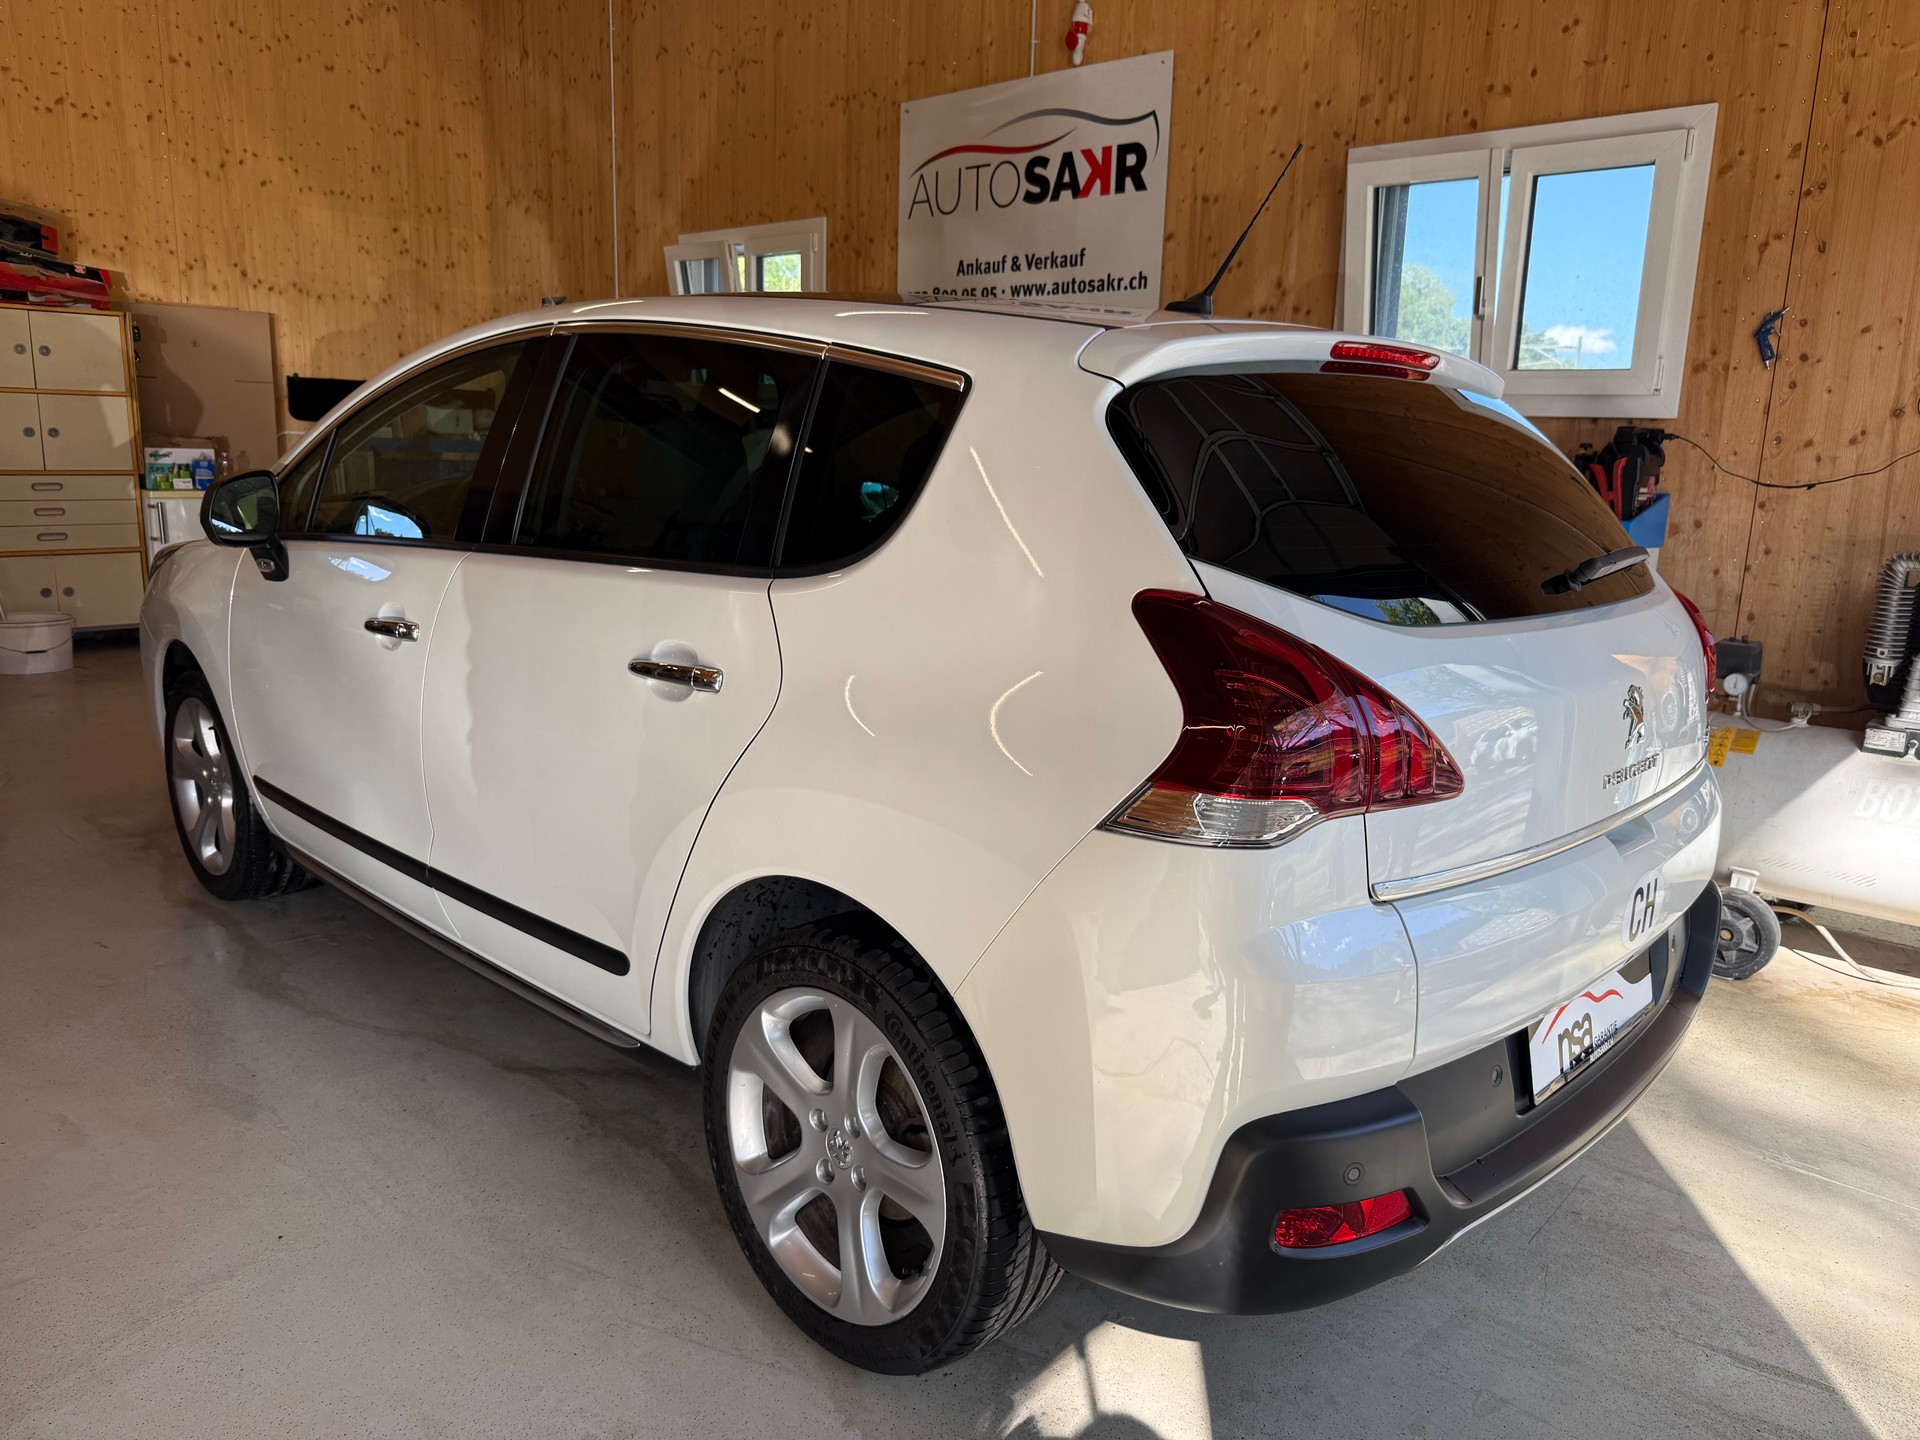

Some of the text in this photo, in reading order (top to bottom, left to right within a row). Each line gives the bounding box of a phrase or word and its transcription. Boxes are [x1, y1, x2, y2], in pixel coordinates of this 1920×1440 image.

[908, 141, 1148, 220] AUTOSAKR
[956, 248, 1087, 277] Ankauf & Verkauf
[1010, 271, 1148, 298] www.autosakr.ch
[1603, 753, 1660, 790] PEUGEOT
[1629, 878, 1658, 942] CH
[1557, 1012, 1594, 1075] nsa
[883, 1009, 961, 1147] Continental
